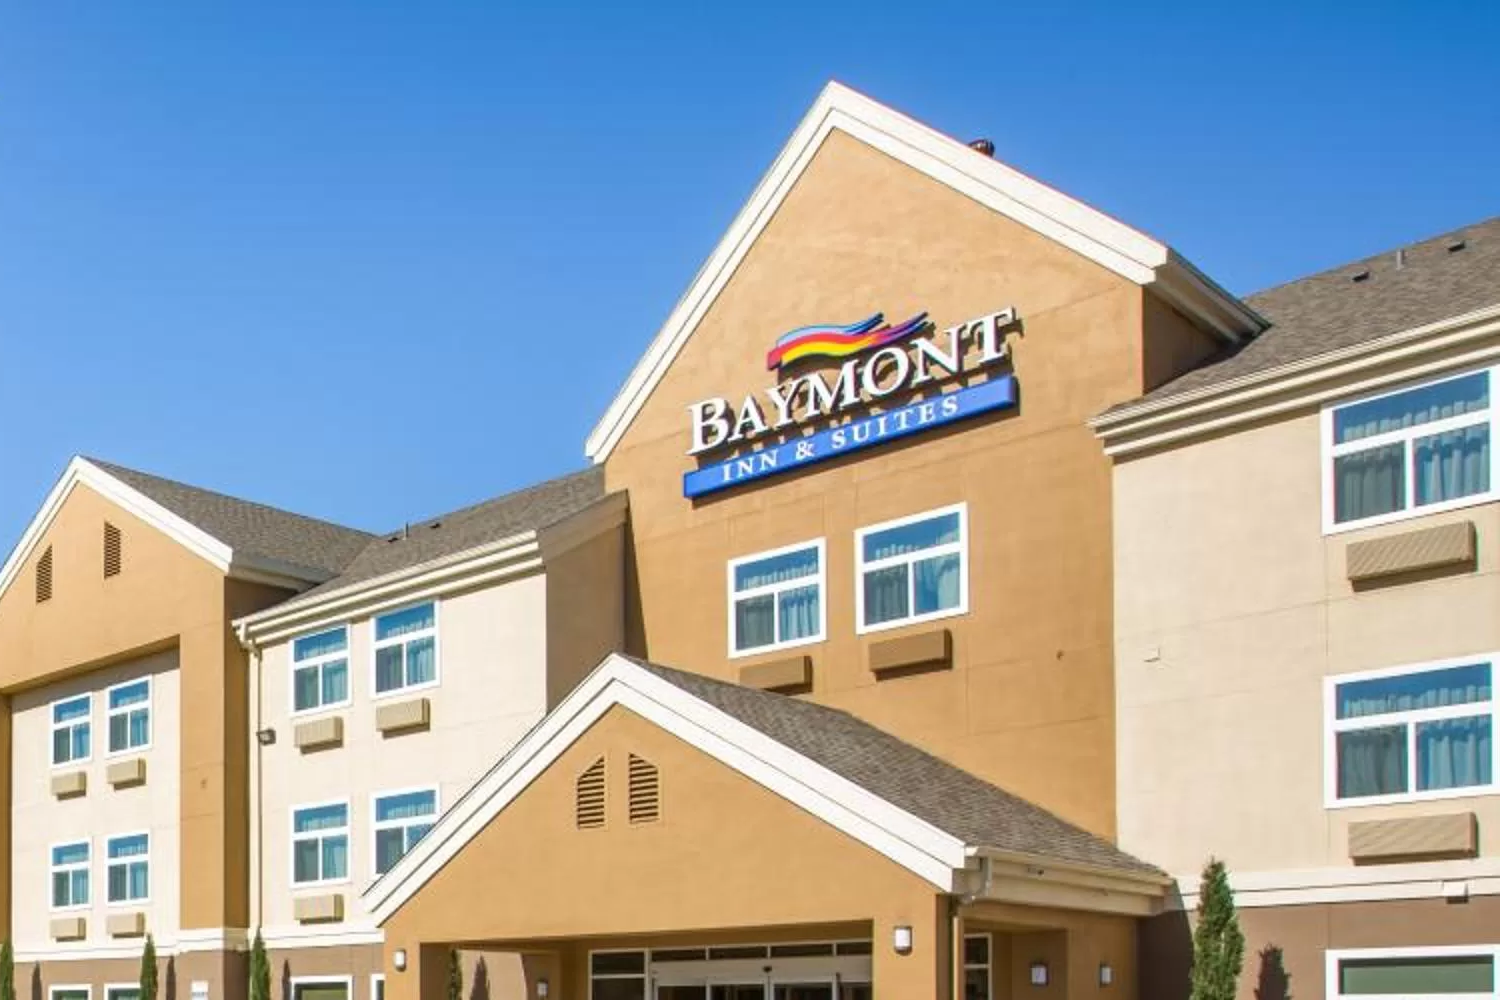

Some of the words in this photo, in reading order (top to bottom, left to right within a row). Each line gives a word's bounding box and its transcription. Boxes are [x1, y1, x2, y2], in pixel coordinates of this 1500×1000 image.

[686, 307, 1016, 456] BAYMONT
[722, 449, 779, 483] INN
[796, 440, 815, 461] &
[831, 394, 960, 449] SUITES
